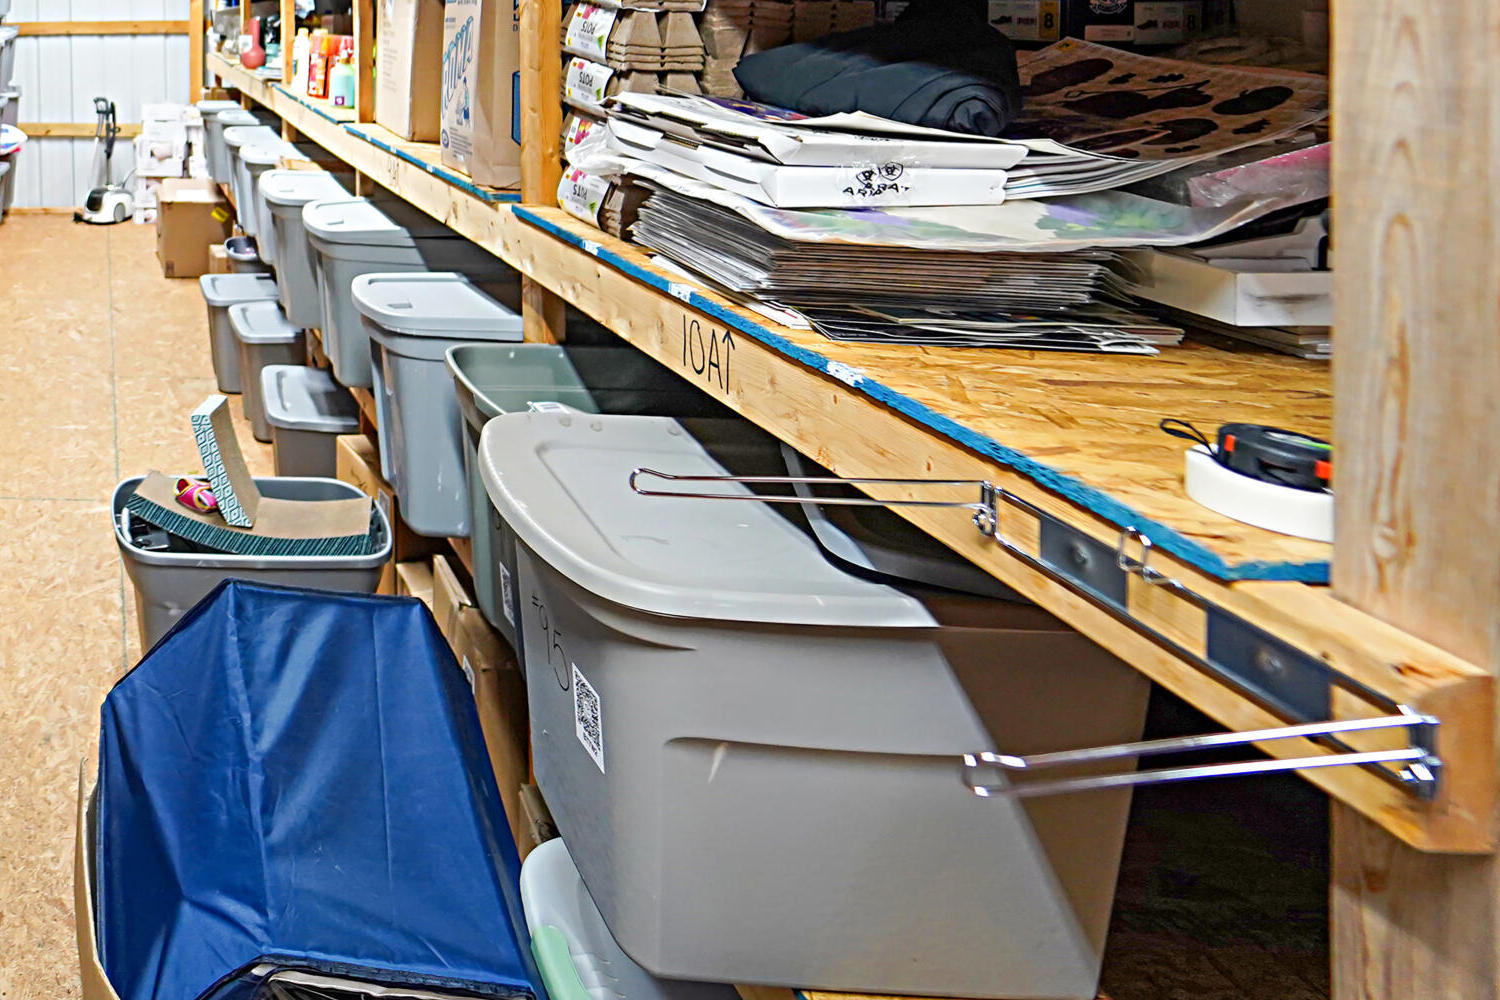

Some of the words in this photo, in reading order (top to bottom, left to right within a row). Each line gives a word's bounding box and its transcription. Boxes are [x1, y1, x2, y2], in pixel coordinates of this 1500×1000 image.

[580, 21, 596, 36] POTS
[1044, 13, 1054, 30] 8
[579, 71, 595, 88] POTS
[572, 184, 588, 200] POTS
